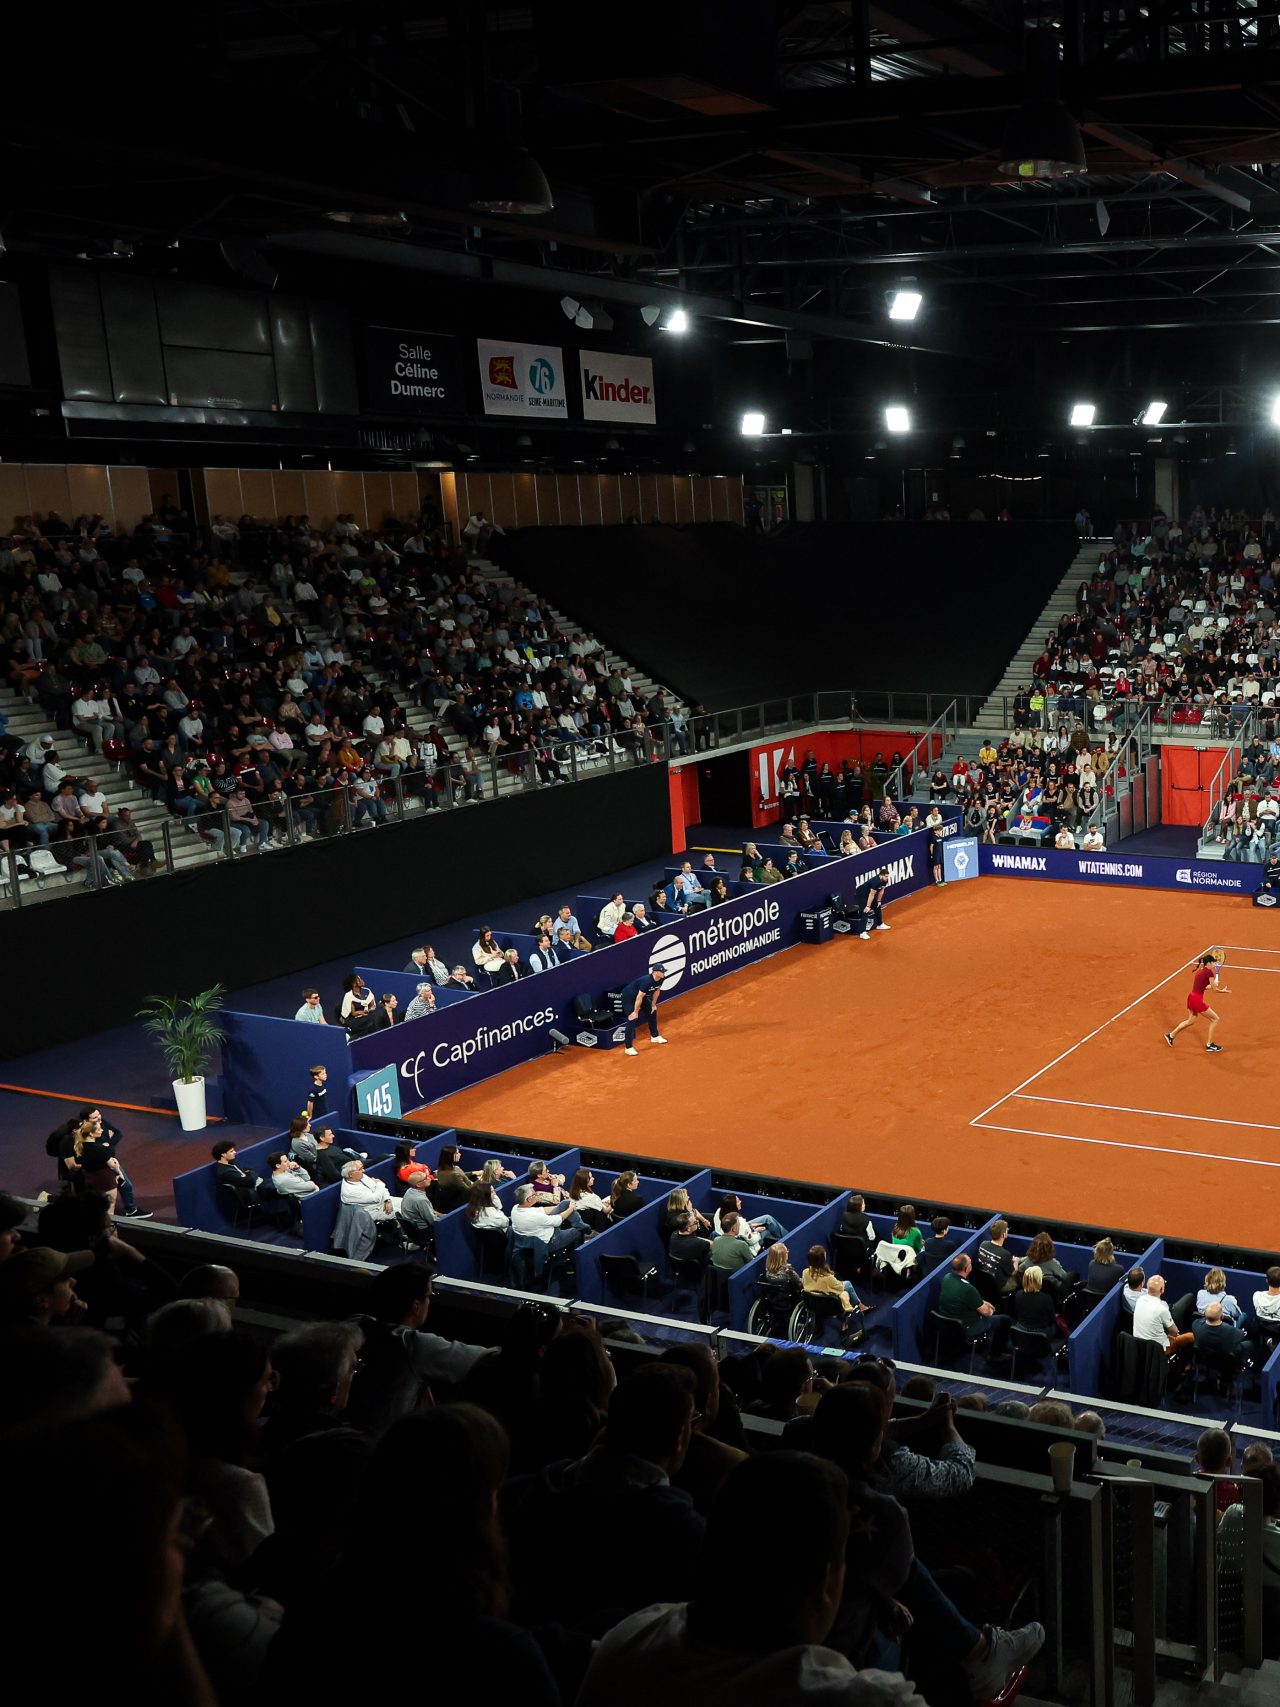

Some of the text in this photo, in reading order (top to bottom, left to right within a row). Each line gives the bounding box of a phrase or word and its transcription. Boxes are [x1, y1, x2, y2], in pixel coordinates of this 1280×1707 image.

[399, 343, 431, 360] Salle
[395, 361, 439, 379] Céline
[531, 361, 549, 392] 76
[390, 380, 445, 398] Dumerc
[486, 393, 525, 402] NORMANDIE
[992, 854, 1046, 871] WINAMAX
[1078, 860, 1143, 878] WTATENNIS.COM
[1193, 877, 1242, 887] NORMANDIE
[688, 900, 780, 954] métropole
[432, 1006, 559, 1068] Capfinances.
[366, 1082, 393, 1116] 145
